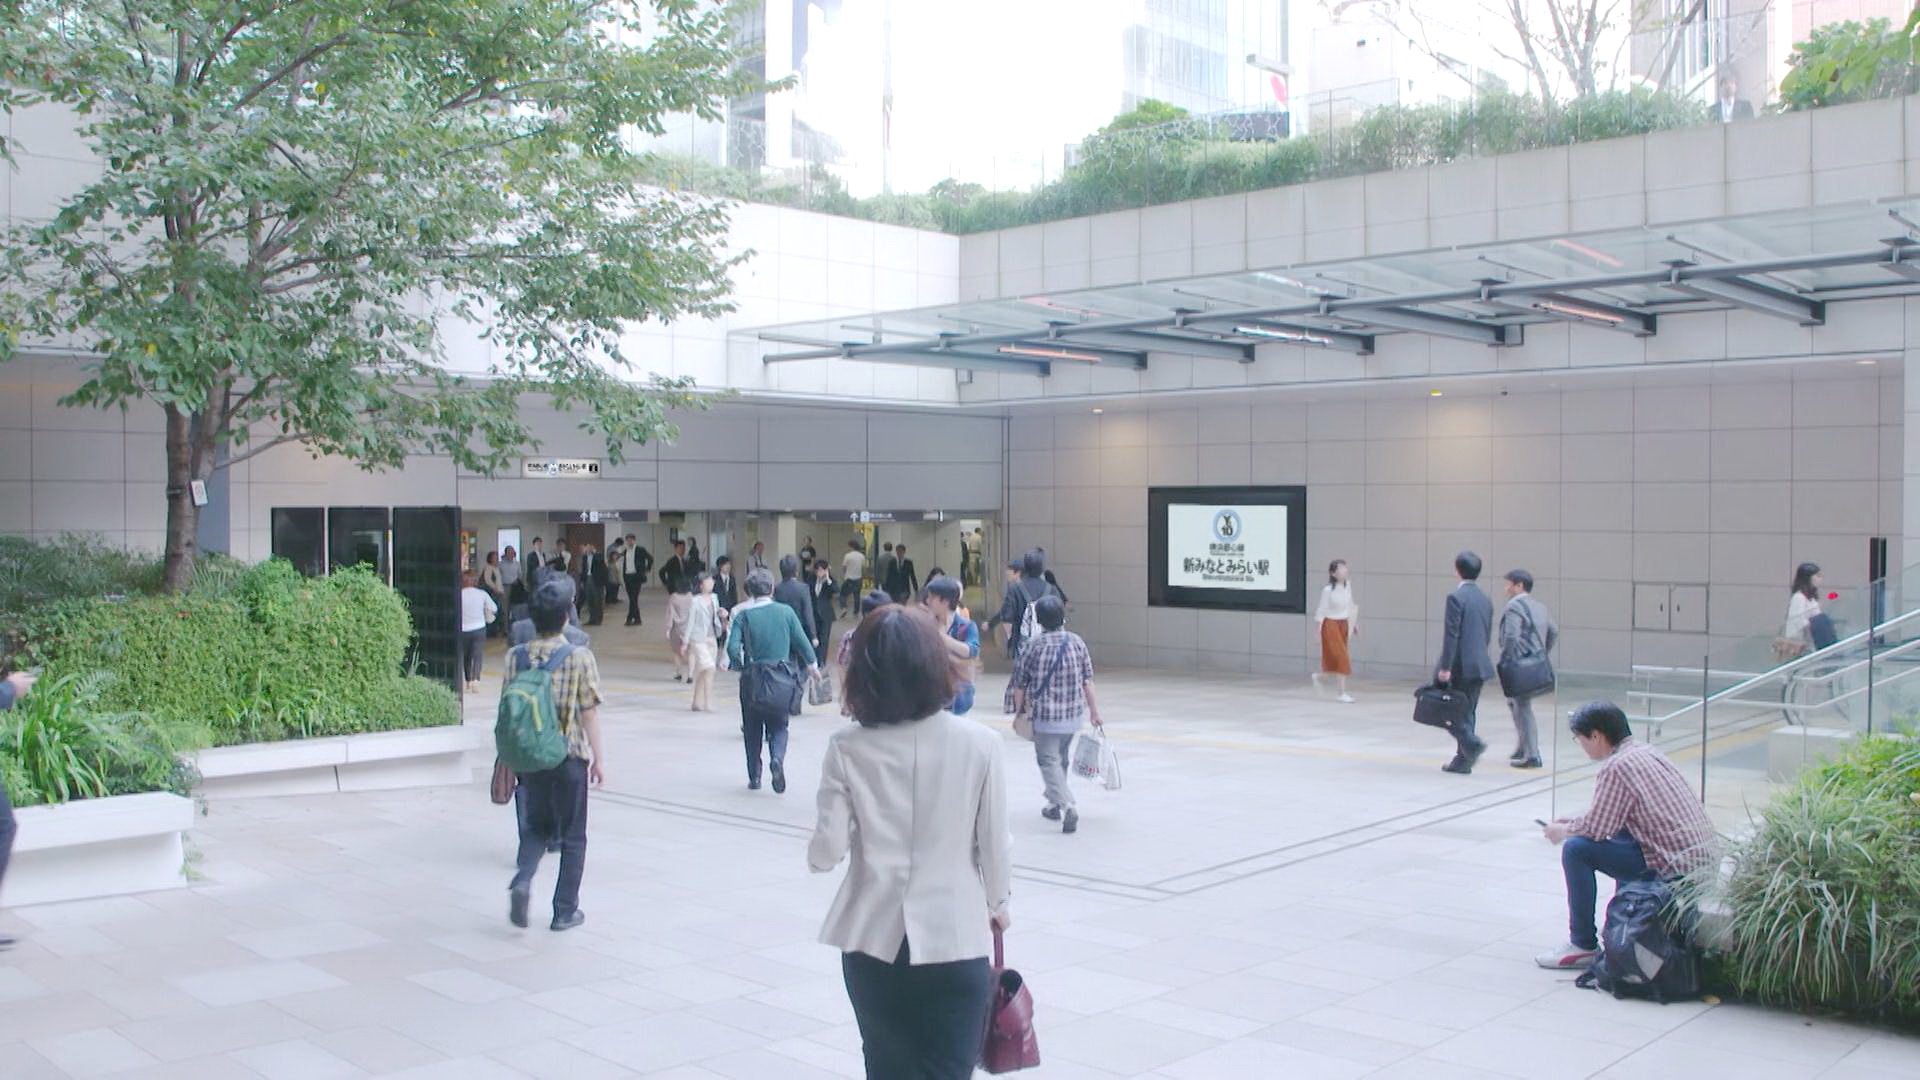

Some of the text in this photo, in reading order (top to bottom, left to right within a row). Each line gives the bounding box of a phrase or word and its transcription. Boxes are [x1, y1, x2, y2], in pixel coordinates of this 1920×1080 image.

[1183, 557, 1270, 576] 新みなとみらい駅
